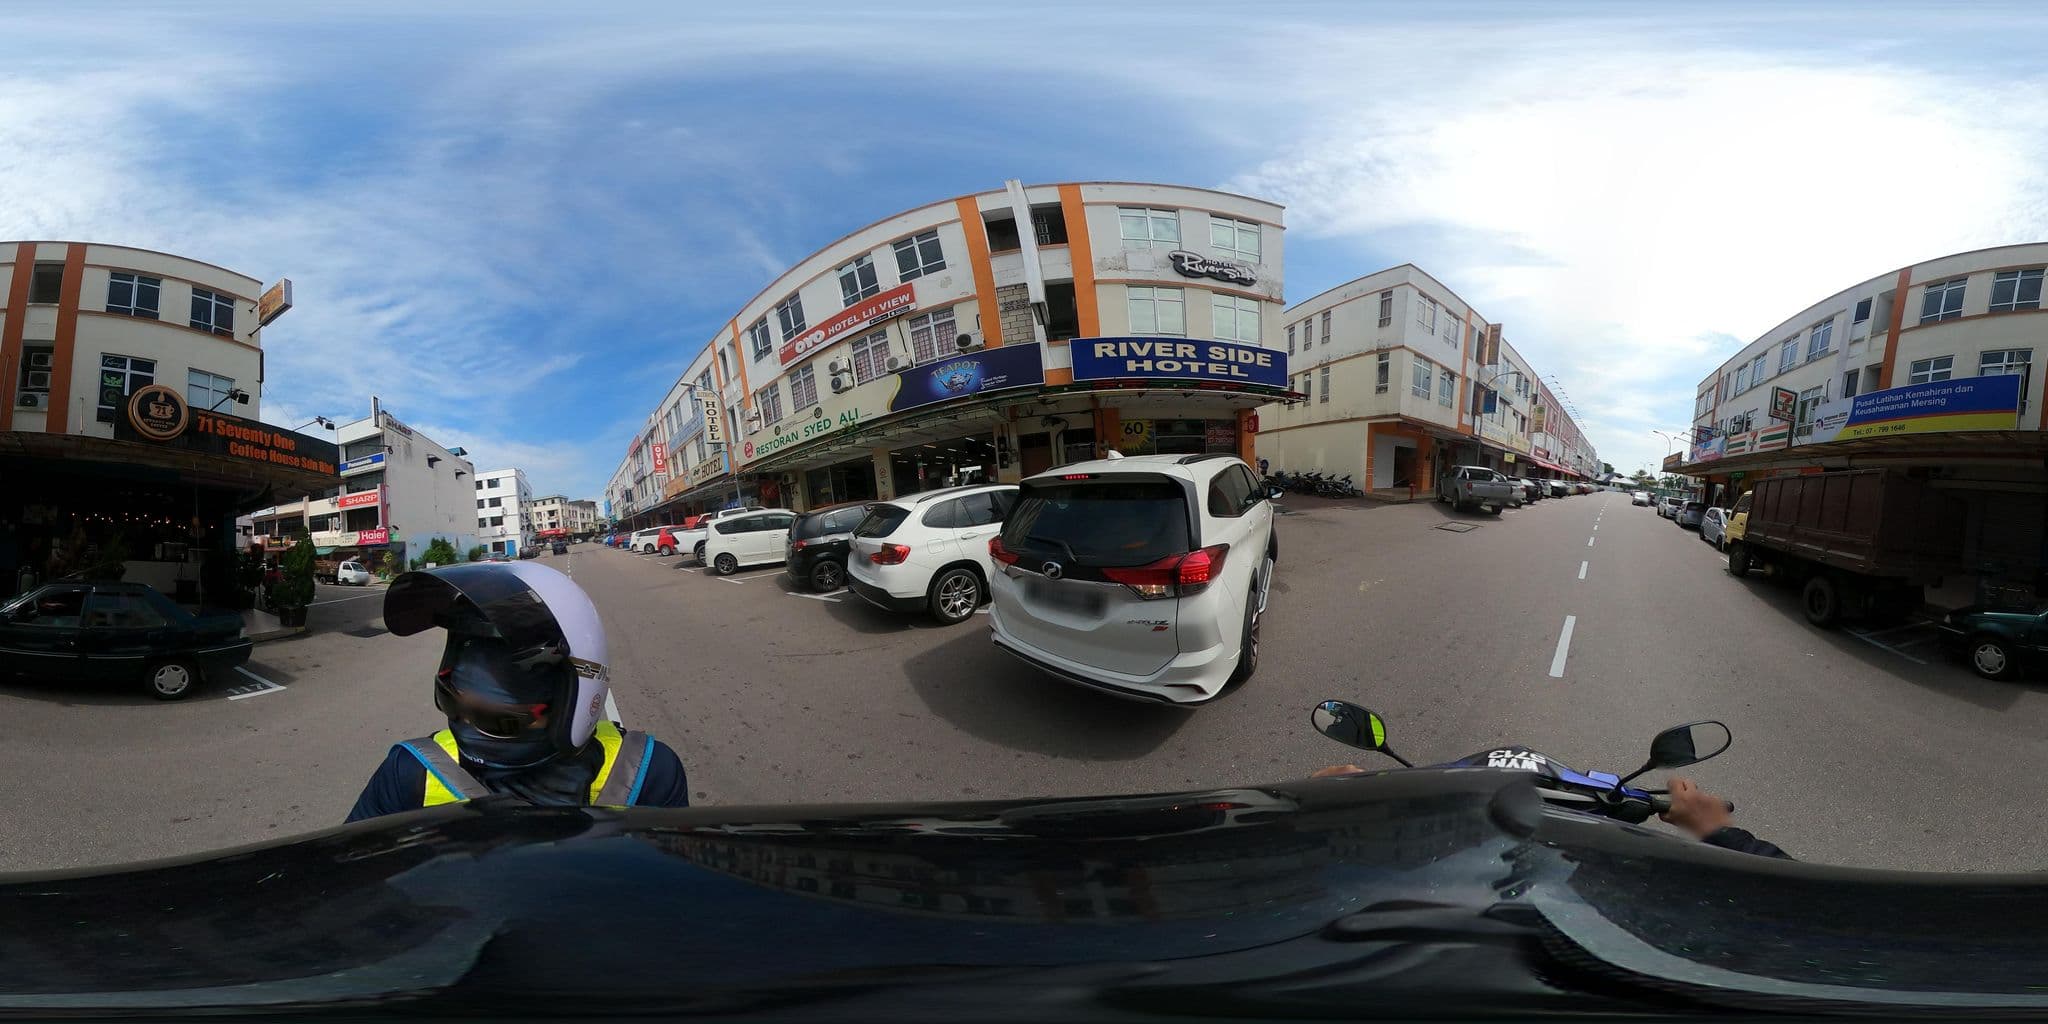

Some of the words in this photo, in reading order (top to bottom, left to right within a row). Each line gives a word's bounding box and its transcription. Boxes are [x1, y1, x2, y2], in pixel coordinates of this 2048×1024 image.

[1206, 259, 1232, 268] HOTEL
[795, 330, 826, 354] OYO
[828, 314, 860, 336] HOTEL
[862, 308, 877, 319] LII
[879, 293, 911, 311] VIEW
[1094, 342, 1197, 359] RIVER
[1208, 346, 1272, 367] SIDE
[931, 360, 980, 379] TEAPOT
[1127, 359, 1249, 377] HOTEL
[1856, 398, 1875, 408] Pusat
[1876, 394, 1904, 404] Latihan
[1905, 386, 1953, 399] Kemahiran
[1954, 384, 1974, 394] dan
[155, 405, 166, 415] 71
[1855, 402, 1910, 416] Keusahawanan
[1911, 397, 1946, 408] Mersing
[385, 417, 412, 436] SHARP
[705, 400, 720, 441] HOTEL
[198, 414, 213, 433] 71
[216, 419, 272, 447] Seventy
[273, 433, 296, 451] One
[755, 431, 799, 457] RESTORAN
[803, 418, 832, 437] SYED
[839, 407, 859, 425] ALI
[229, 441, 267, 460] Coffee
[269, 449, 300, 467] House
[300, 457, 318, 471] Sdn
[655, 446, 663, 465] OYO
[701, 457, 723, 478] HOTEL
[345, 494, 377, 506] SHARP
[361, 530, 386, 541] Haier
[1487, 758, 1539, 773] WYM
